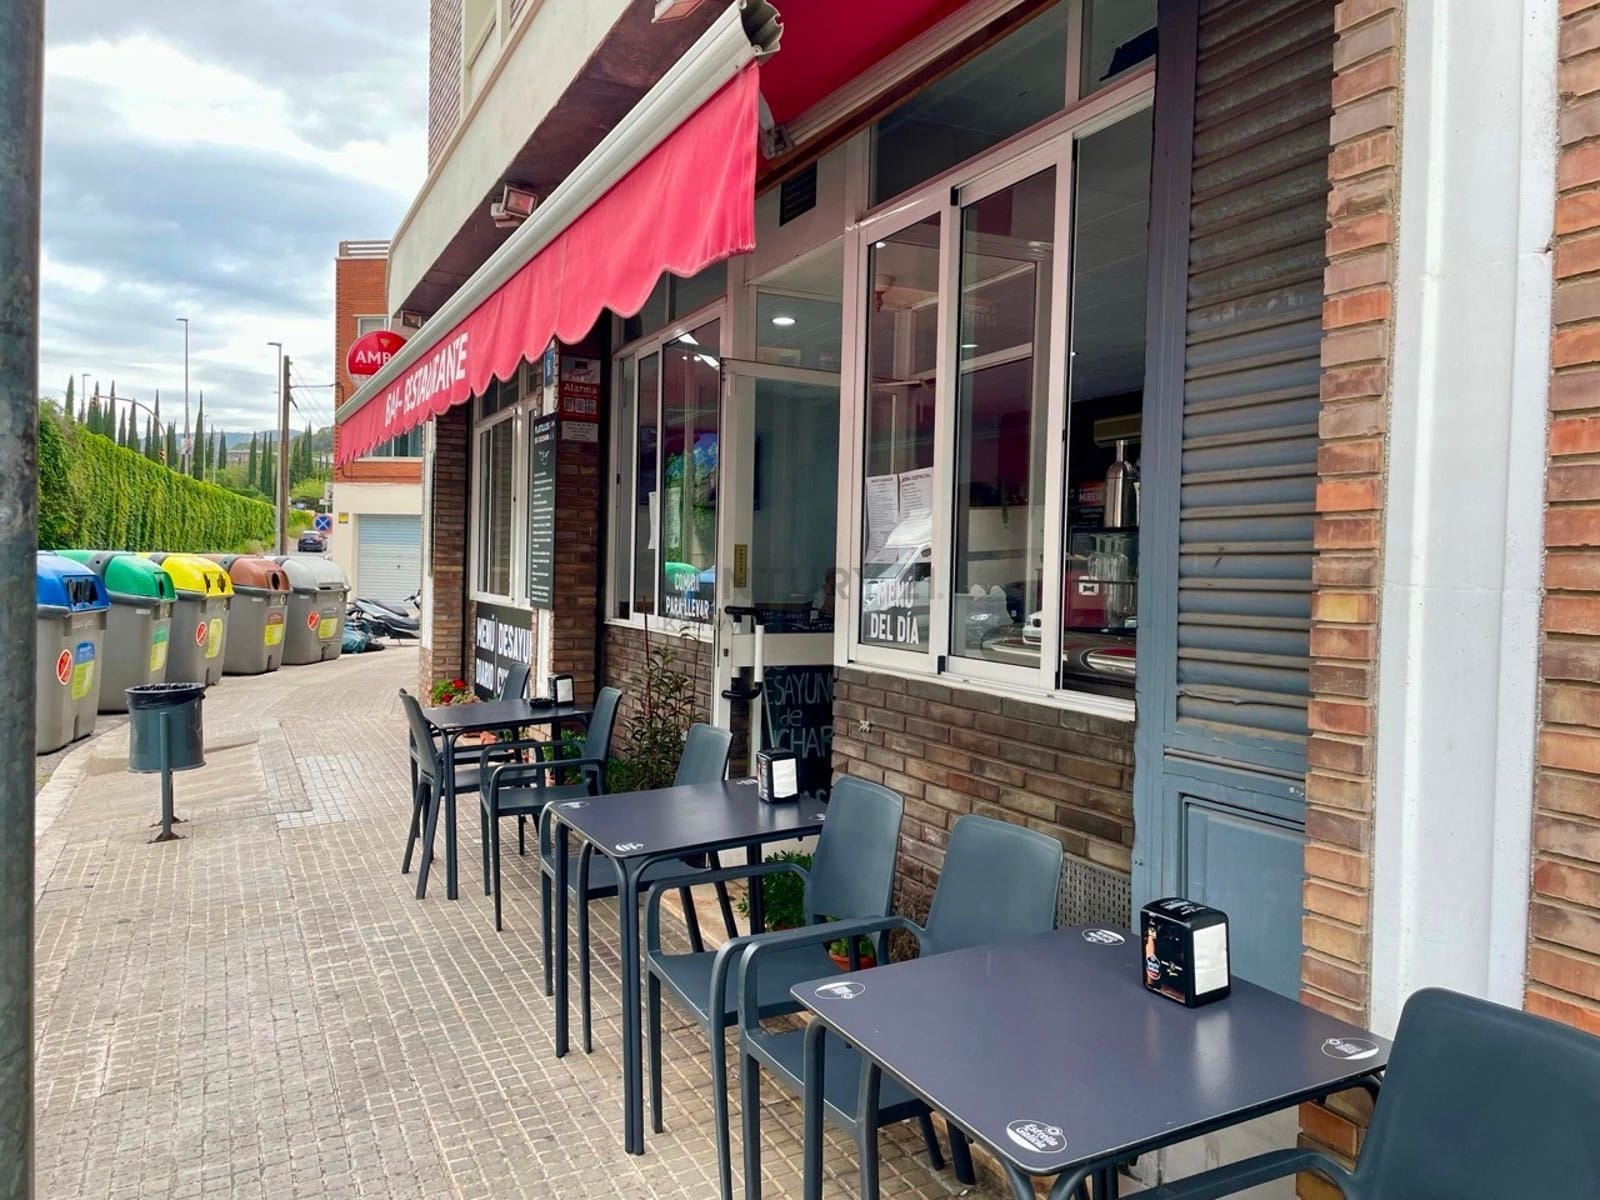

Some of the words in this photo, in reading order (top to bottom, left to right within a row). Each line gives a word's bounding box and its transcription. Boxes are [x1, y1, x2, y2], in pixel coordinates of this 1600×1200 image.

[563, 383, 598, 394] Alarma
[877, 576, 914, 608] MENÚ
[870, 612, 893, 641] DEL
[897, 610, 920, 645] DÍA
[763, 672, 833, 706] ESAYUN
[780, 707, 803, 727] de
